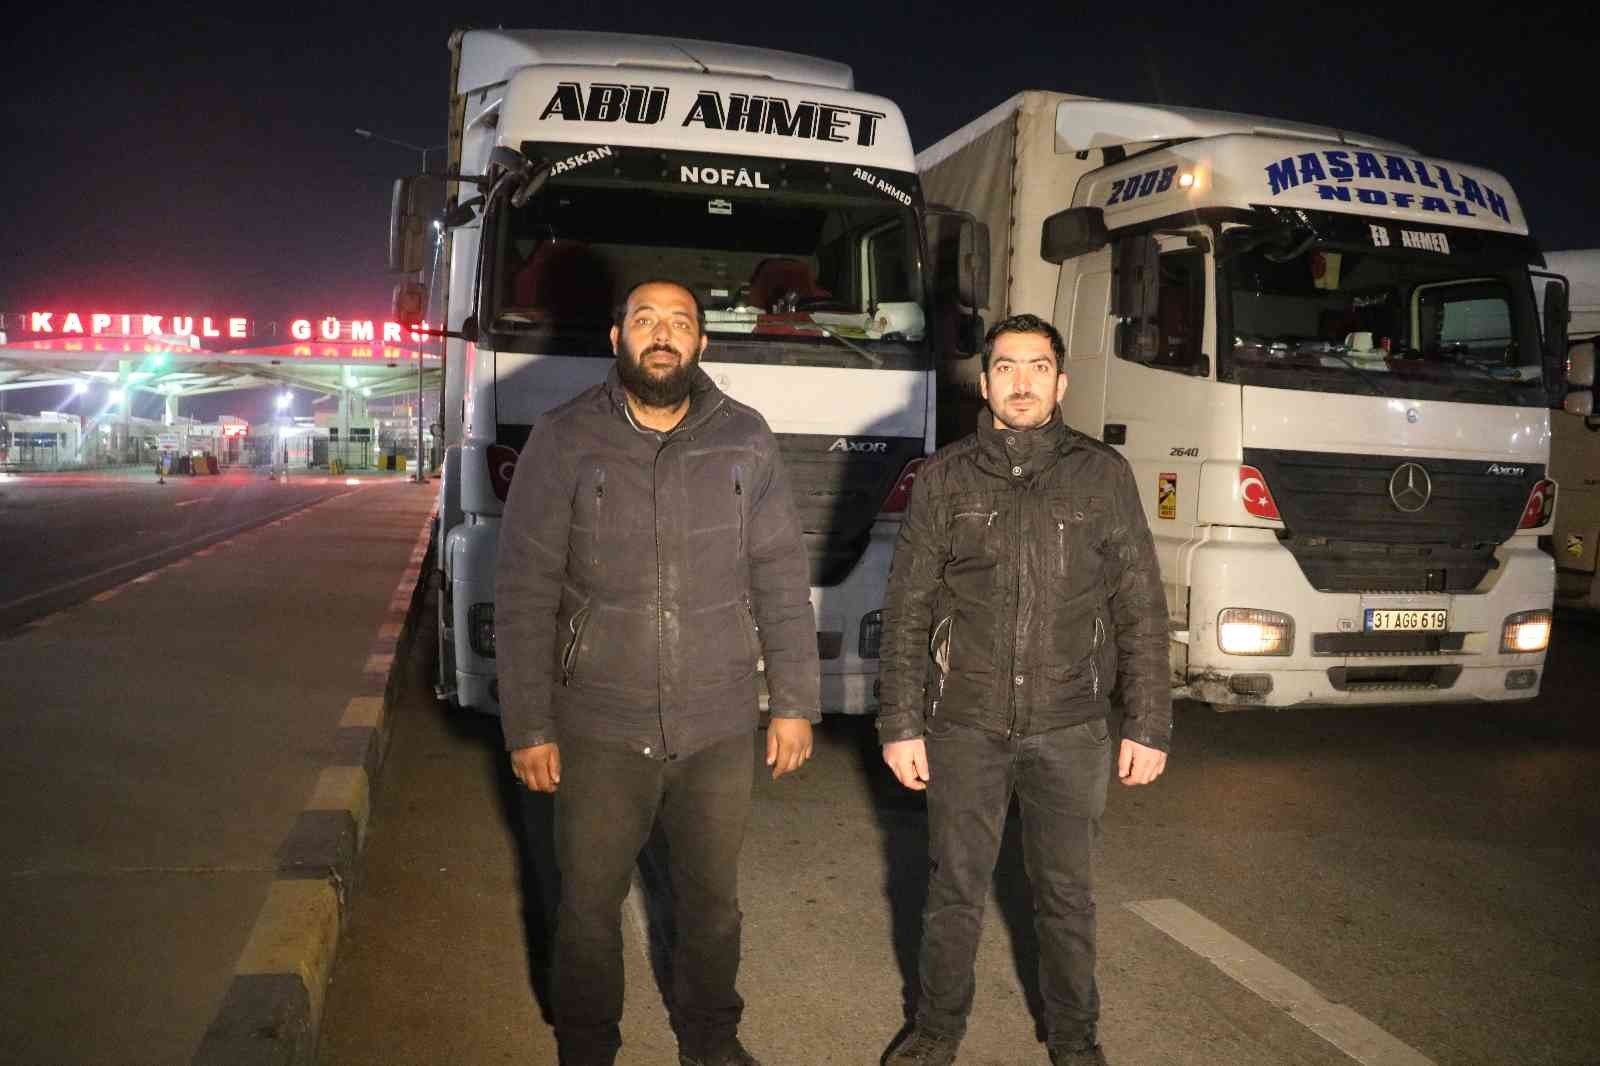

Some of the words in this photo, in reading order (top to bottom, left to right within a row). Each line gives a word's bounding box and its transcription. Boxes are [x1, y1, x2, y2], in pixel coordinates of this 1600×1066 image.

[539, 82, 670, 125] ABU
[681, 90, 886, 147] AHMET
[853, 168, 876, 185] ABU
[877, 179, 912, 206] AHMED
[1106, 165, 1178, 206] 2008
[31, 311, 247, 338] KAPIKULE
[828, 438, 887, 452] AXOR
[1169, 447, 1199, 456] 2640
[1374, 612, 1390, 628] 31
[1395, 612, 1418, 628] AGG
[1421, 612, 1445, 628] 619
